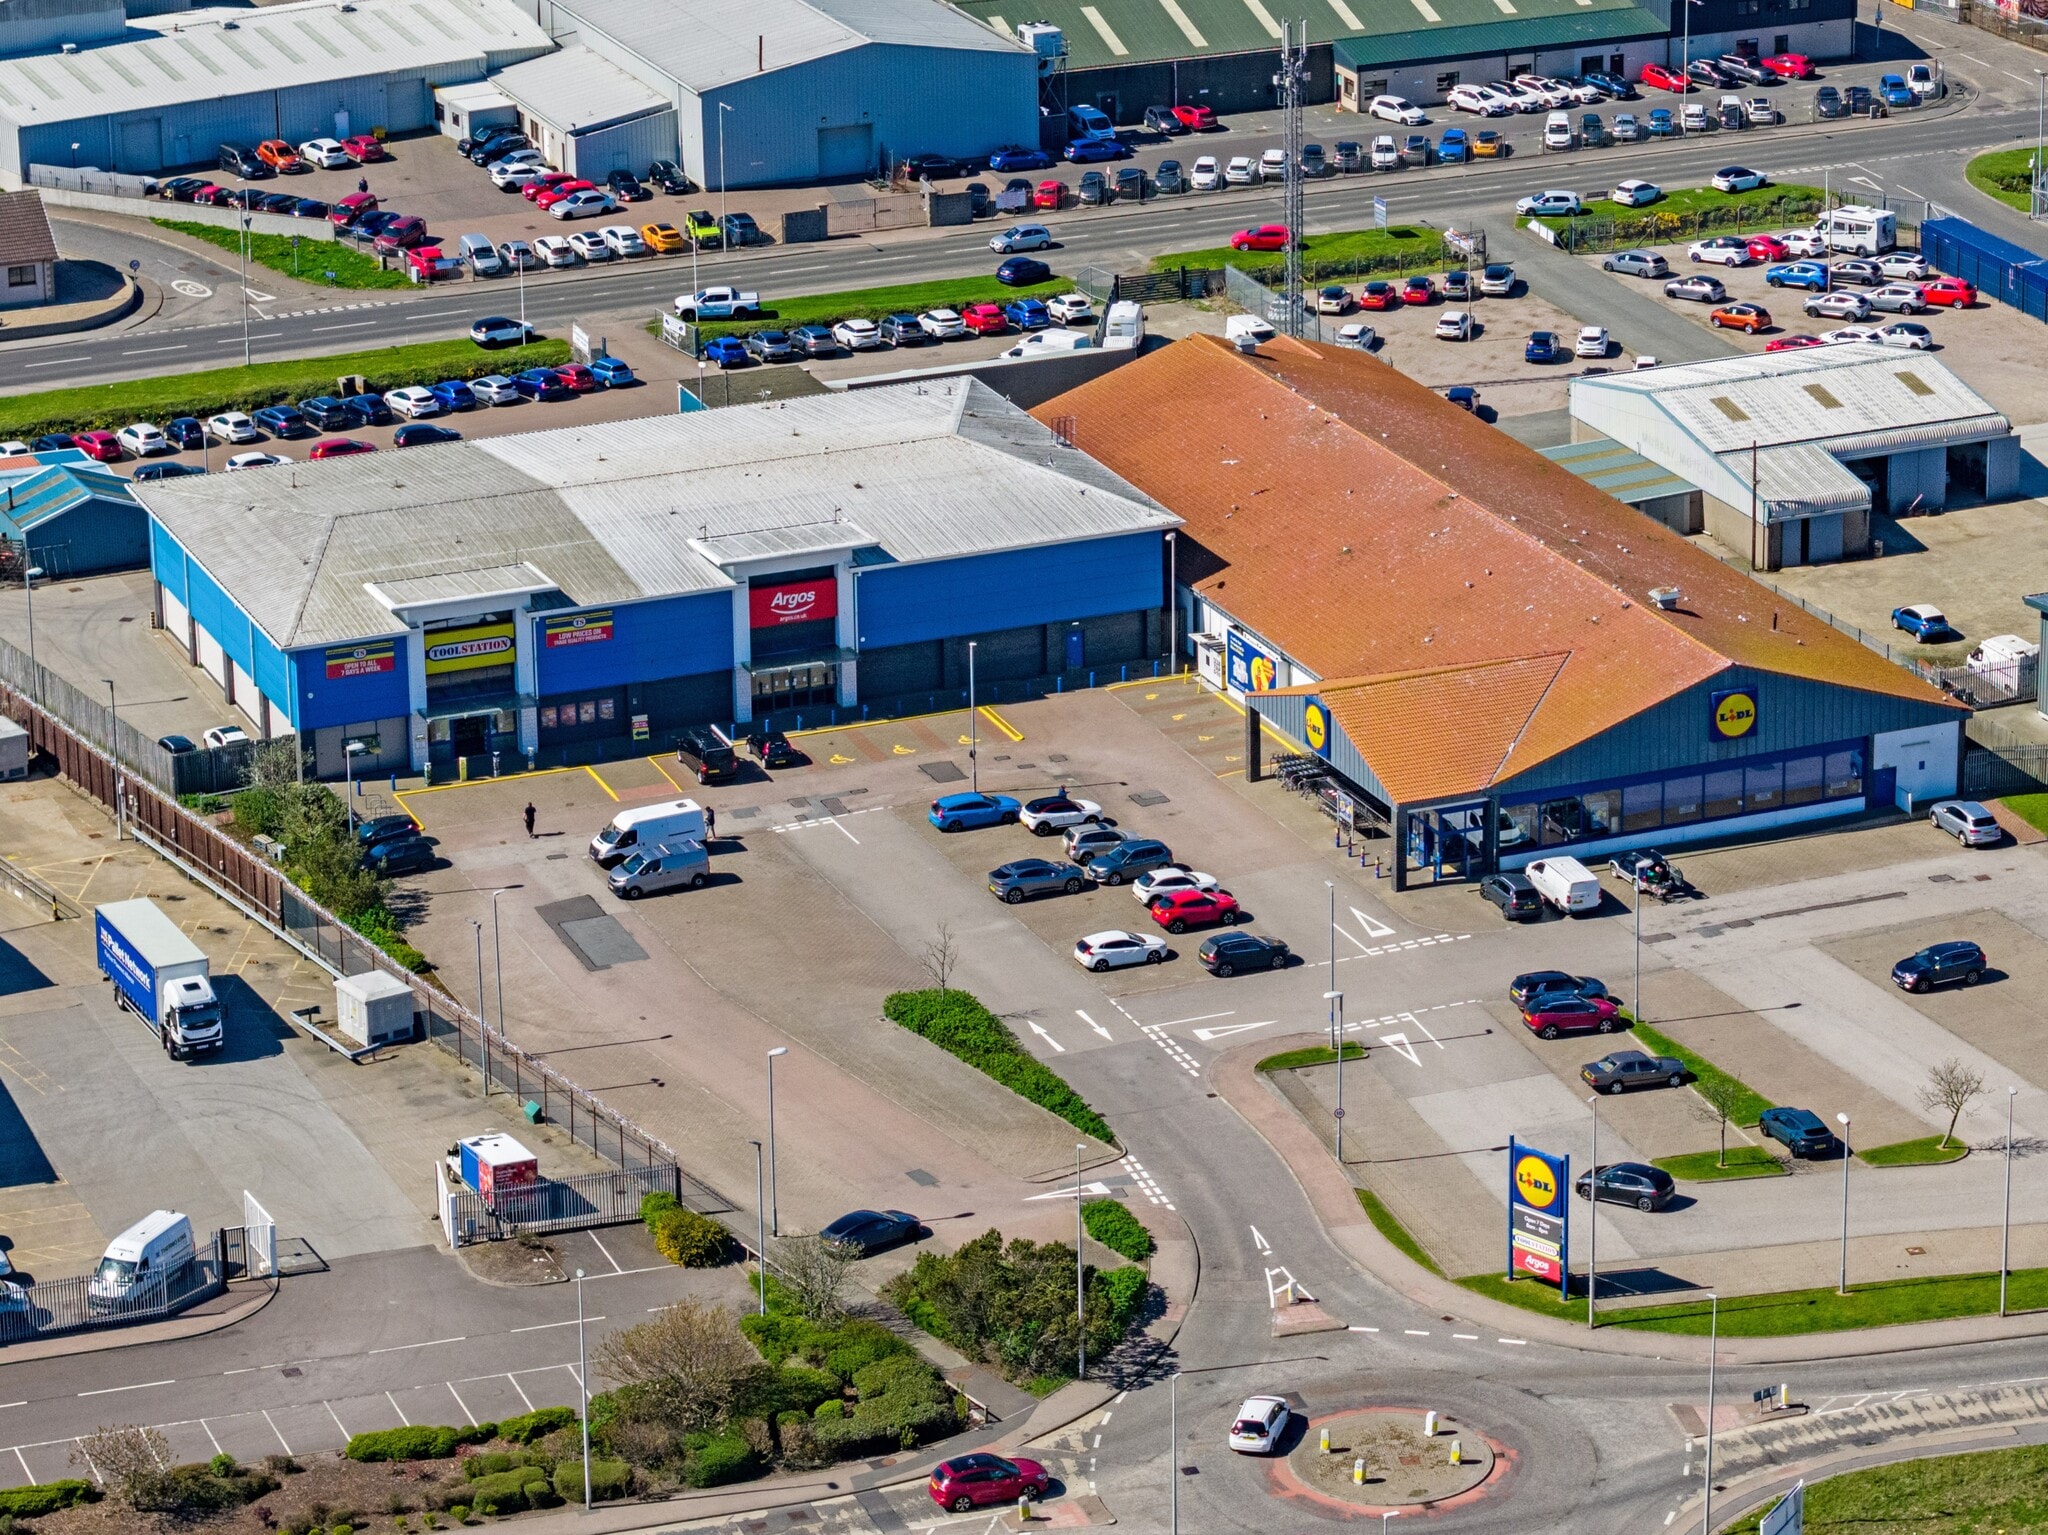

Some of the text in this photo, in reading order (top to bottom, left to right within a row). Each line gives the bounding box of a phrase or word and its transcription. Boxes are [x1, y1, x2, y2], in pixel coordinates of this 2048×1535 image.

[770, 591, 816, 608] Argos
[558, 632, 572, 640] LOW
[572, 629, 593, 638] PRICES
[431, 639, 509, 658] TOOLSTATION
[344, 661, 359, 670] OPEN
[367, 659, 377, 667] ALL
[345, 668, 360, 676] DAYS
[124, 951, 151, 990] Network
[1524, 1254, 1550, 1270] Argos
